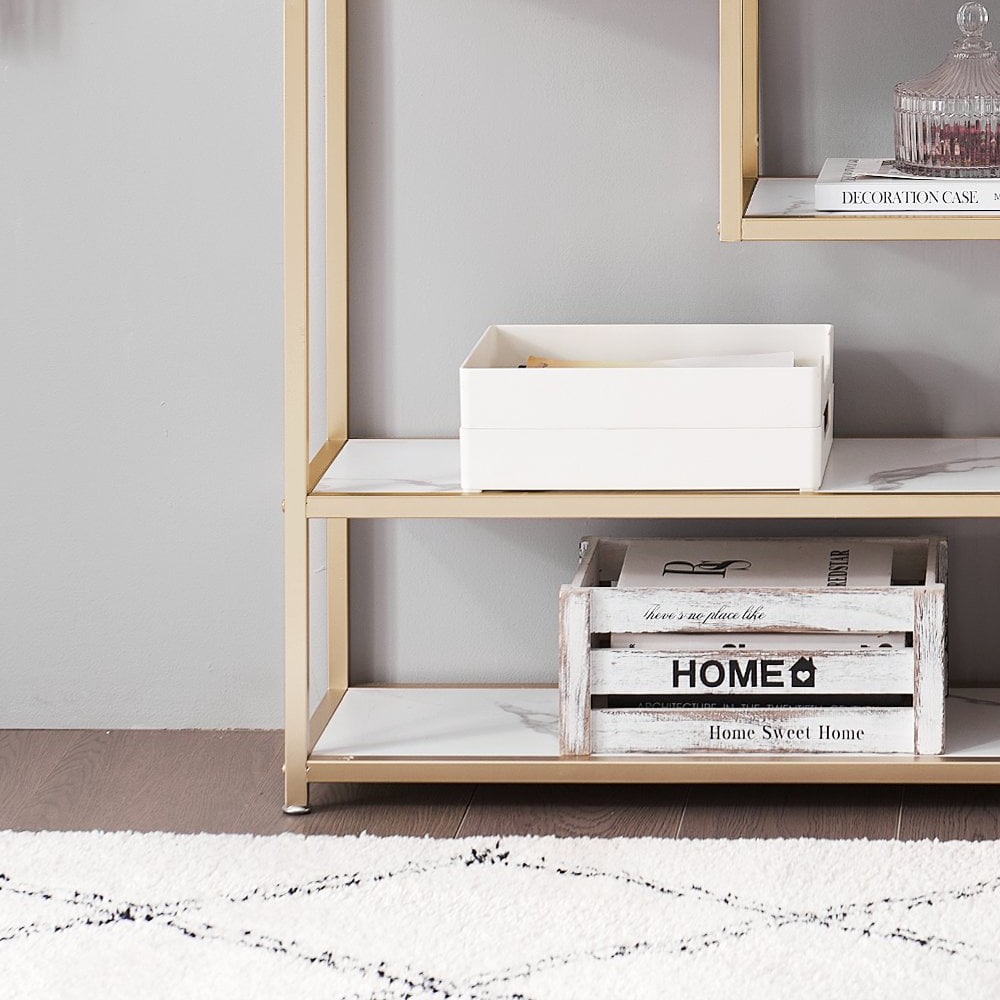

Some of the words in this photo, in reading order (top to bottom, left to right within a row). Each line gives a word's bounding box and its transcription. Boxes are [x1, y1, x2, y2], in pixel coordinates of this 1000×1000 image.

[841, 190, 939, 204] DECORATION
[942, 190, 980, 204] CASE
[827, 549, 850, 587] REDSTAR
[687, 610, 705, 620] no
[701, 603, 740, 625] place
[740, 603, 767, 621] like
[672, 659, 785, 688] HOME
[709, 725, 755, 740] Home
[762, 725, 810, 740] Sweet
[819, 725, 865, 740] Home
